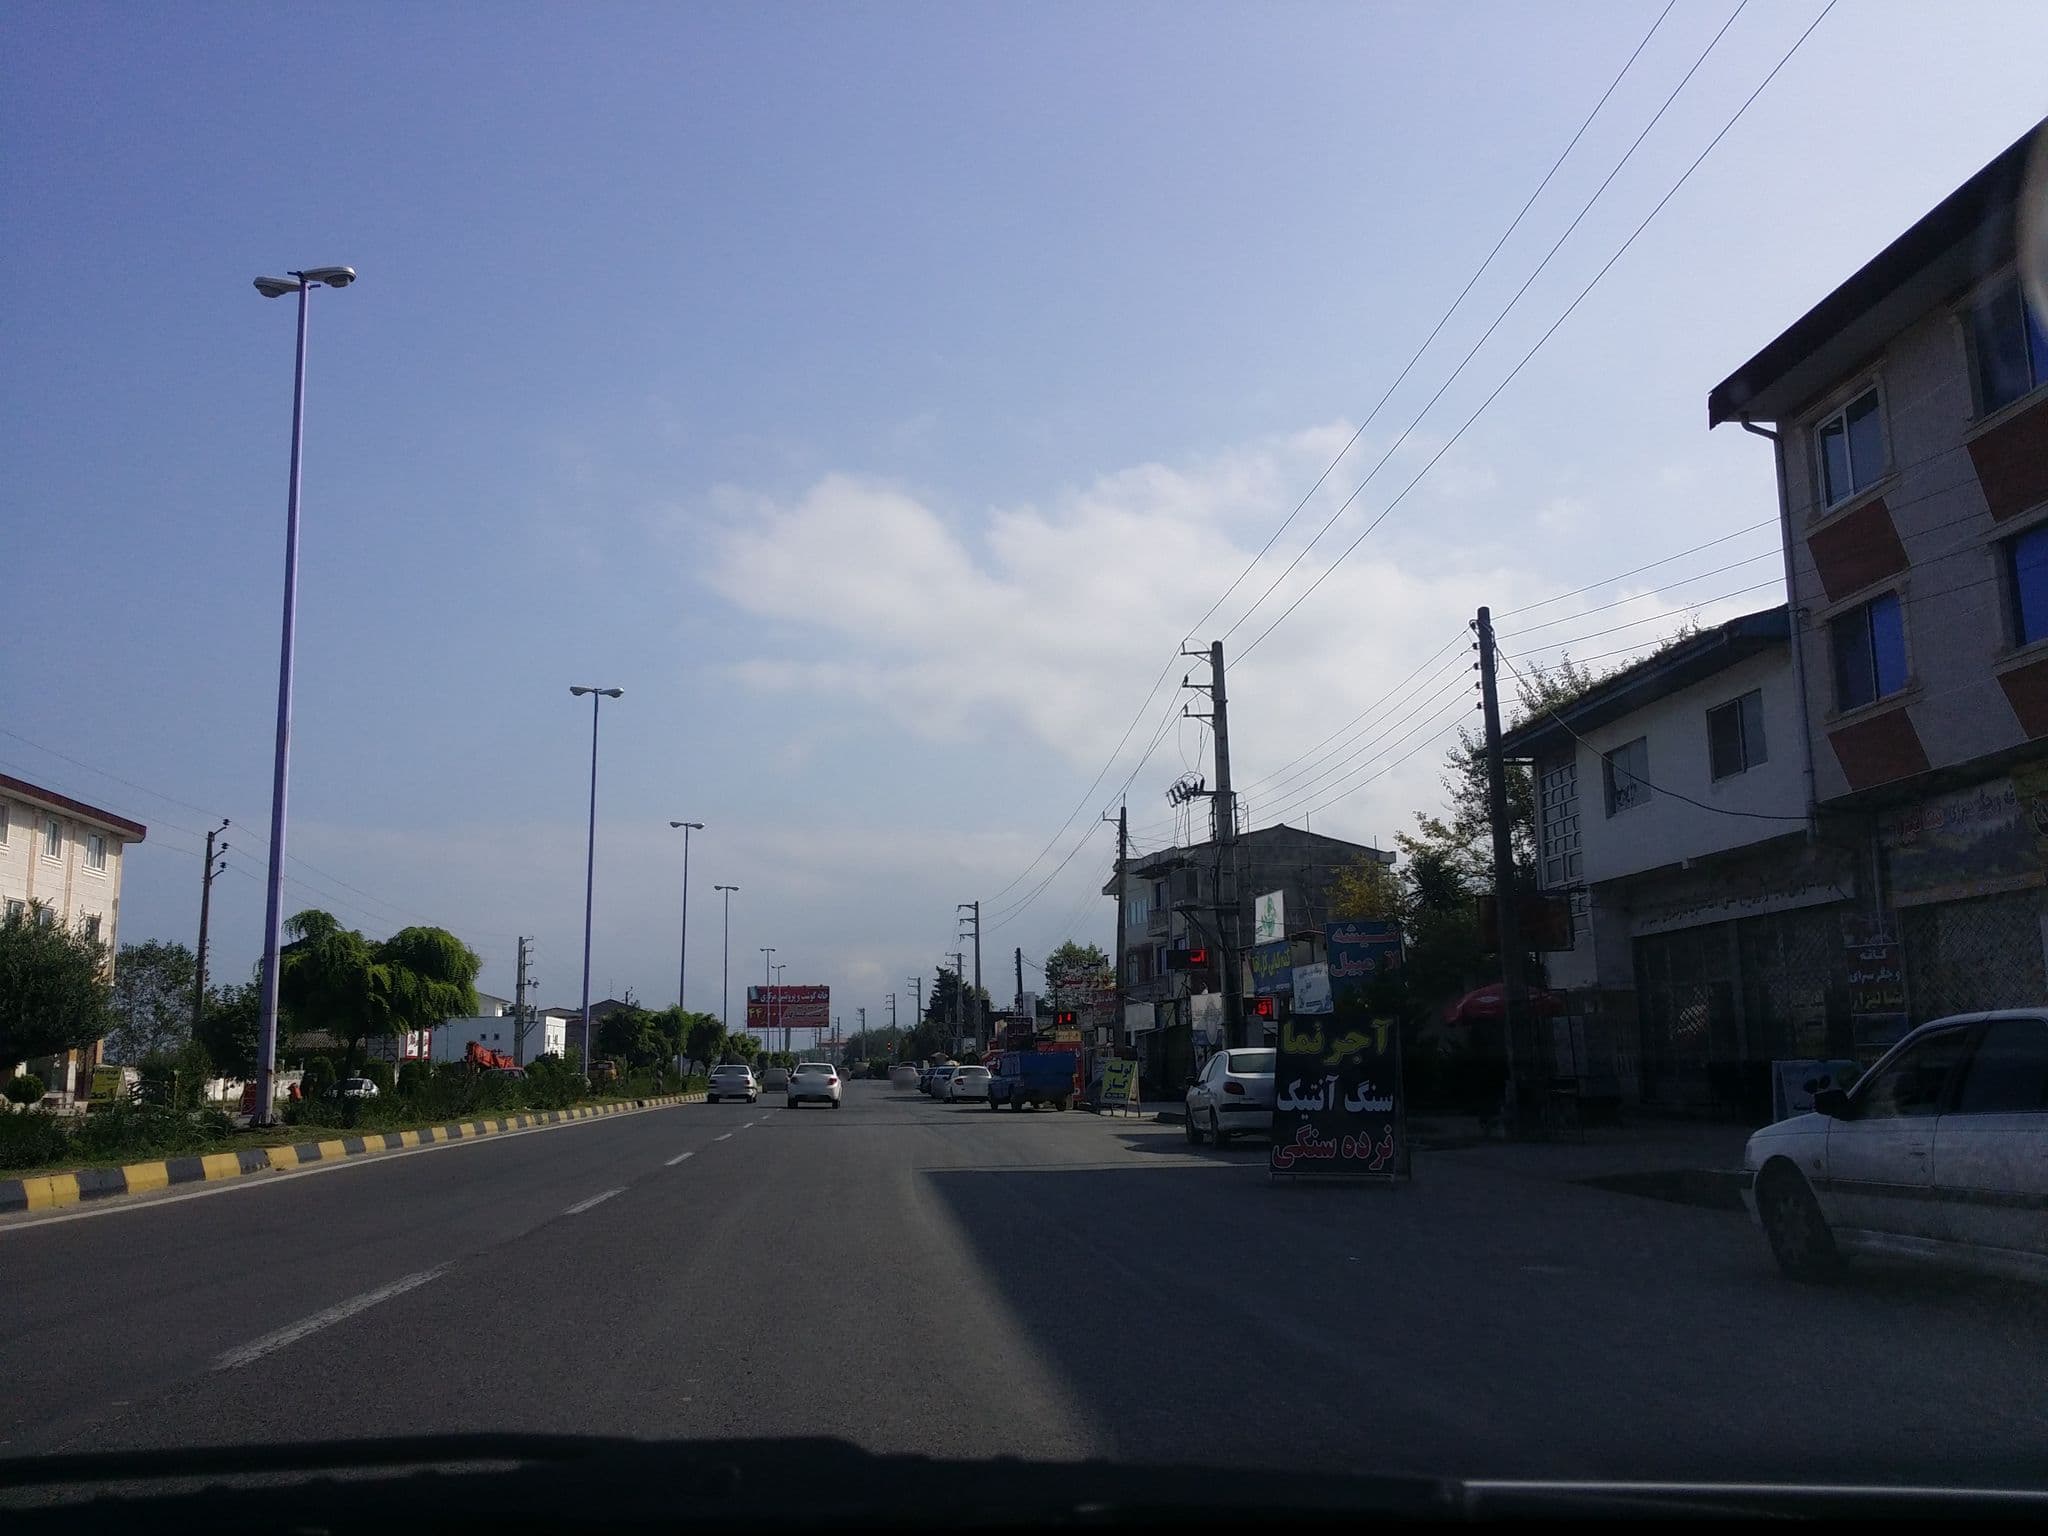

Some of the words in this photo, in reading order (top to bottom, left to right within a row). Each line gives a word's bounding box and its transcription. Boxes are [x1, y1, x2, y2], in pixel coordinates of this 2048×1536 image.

[1332, 923, 1400, 949] شیشه
[1849, 969, 1875, 985] سرای
[1281, 1022, 1326, 1055] نما
[1321, 1016, 1394, 1065] آجر
[1107, 1063, 1133, 1078] لوله
[1277, 1074, 1341, 1120] آنتیک
[1344, 1079, 1394, 1112] سنگ
[1272, 1123, 1338, 1169] سنگی
